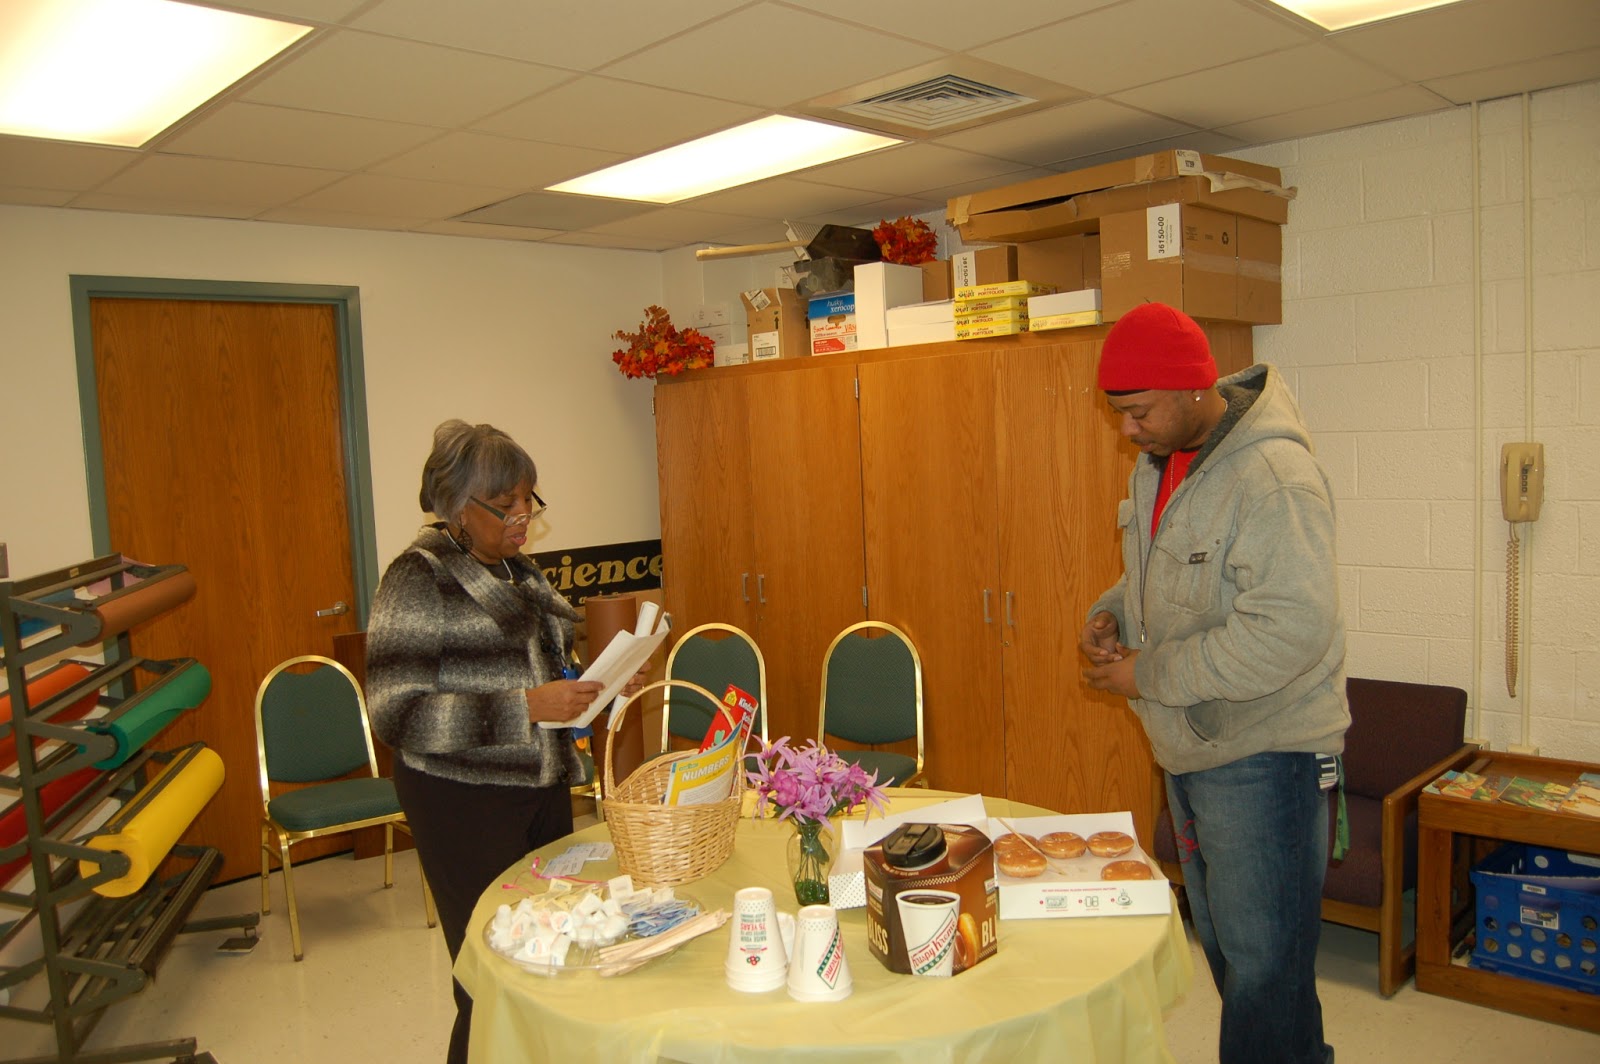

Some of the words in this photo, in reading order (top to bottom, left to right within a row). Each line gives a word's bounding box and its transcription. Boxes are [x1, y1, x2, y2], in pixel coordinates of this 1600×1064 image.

[1157, 216, 1165, 254] 36150-00
[830, 304, 855, 313] xerocop
[533, 554, 663, 590] cience
[682, 754, 731, 782] NUMBERS
[740, 922, 758, 931] YEARS
[981, 914, 997, 948] BLI
